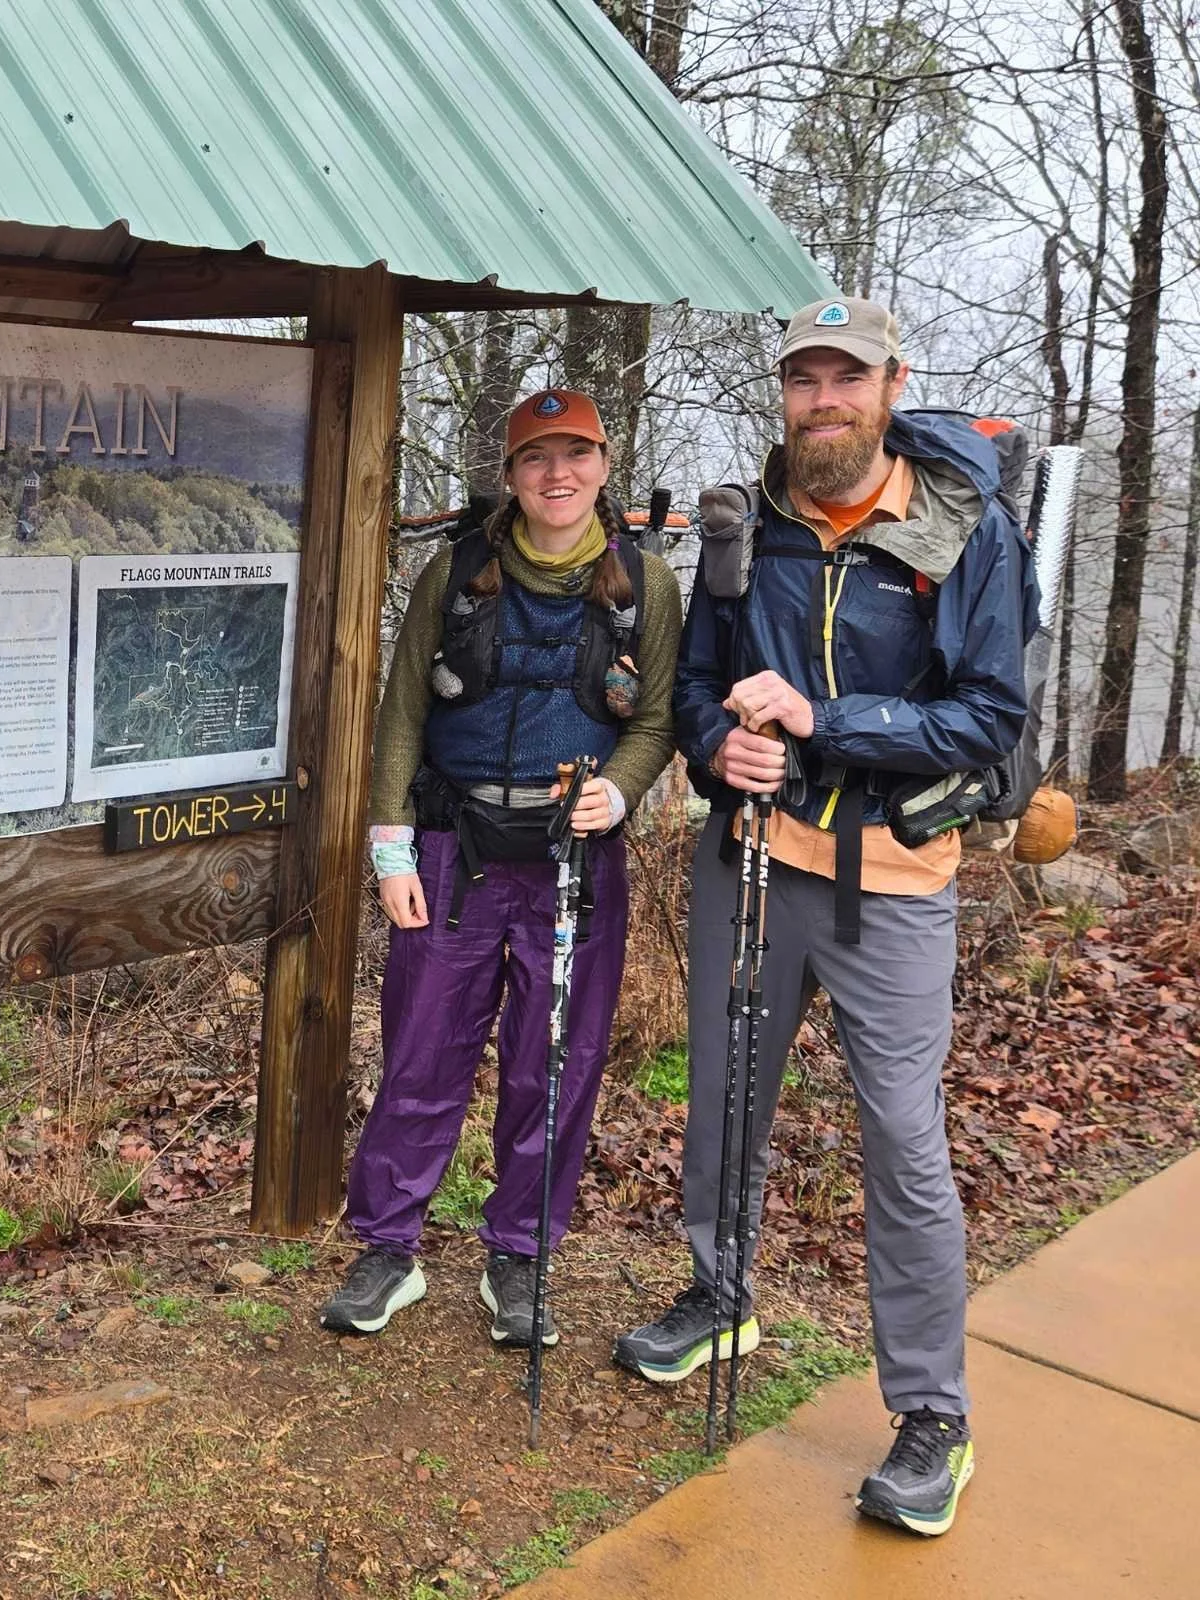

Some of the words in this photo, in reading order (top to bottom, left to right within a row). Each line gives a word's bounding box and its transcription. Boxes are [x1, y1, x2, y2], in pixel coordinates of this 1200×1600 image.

[120, 569, 161, 582] FLAGG
[164, 567, 231, 580] MOUNTAIN
[234, 565, 272, 578] TRAILS
[133, 796, 229, 844] TOWER
